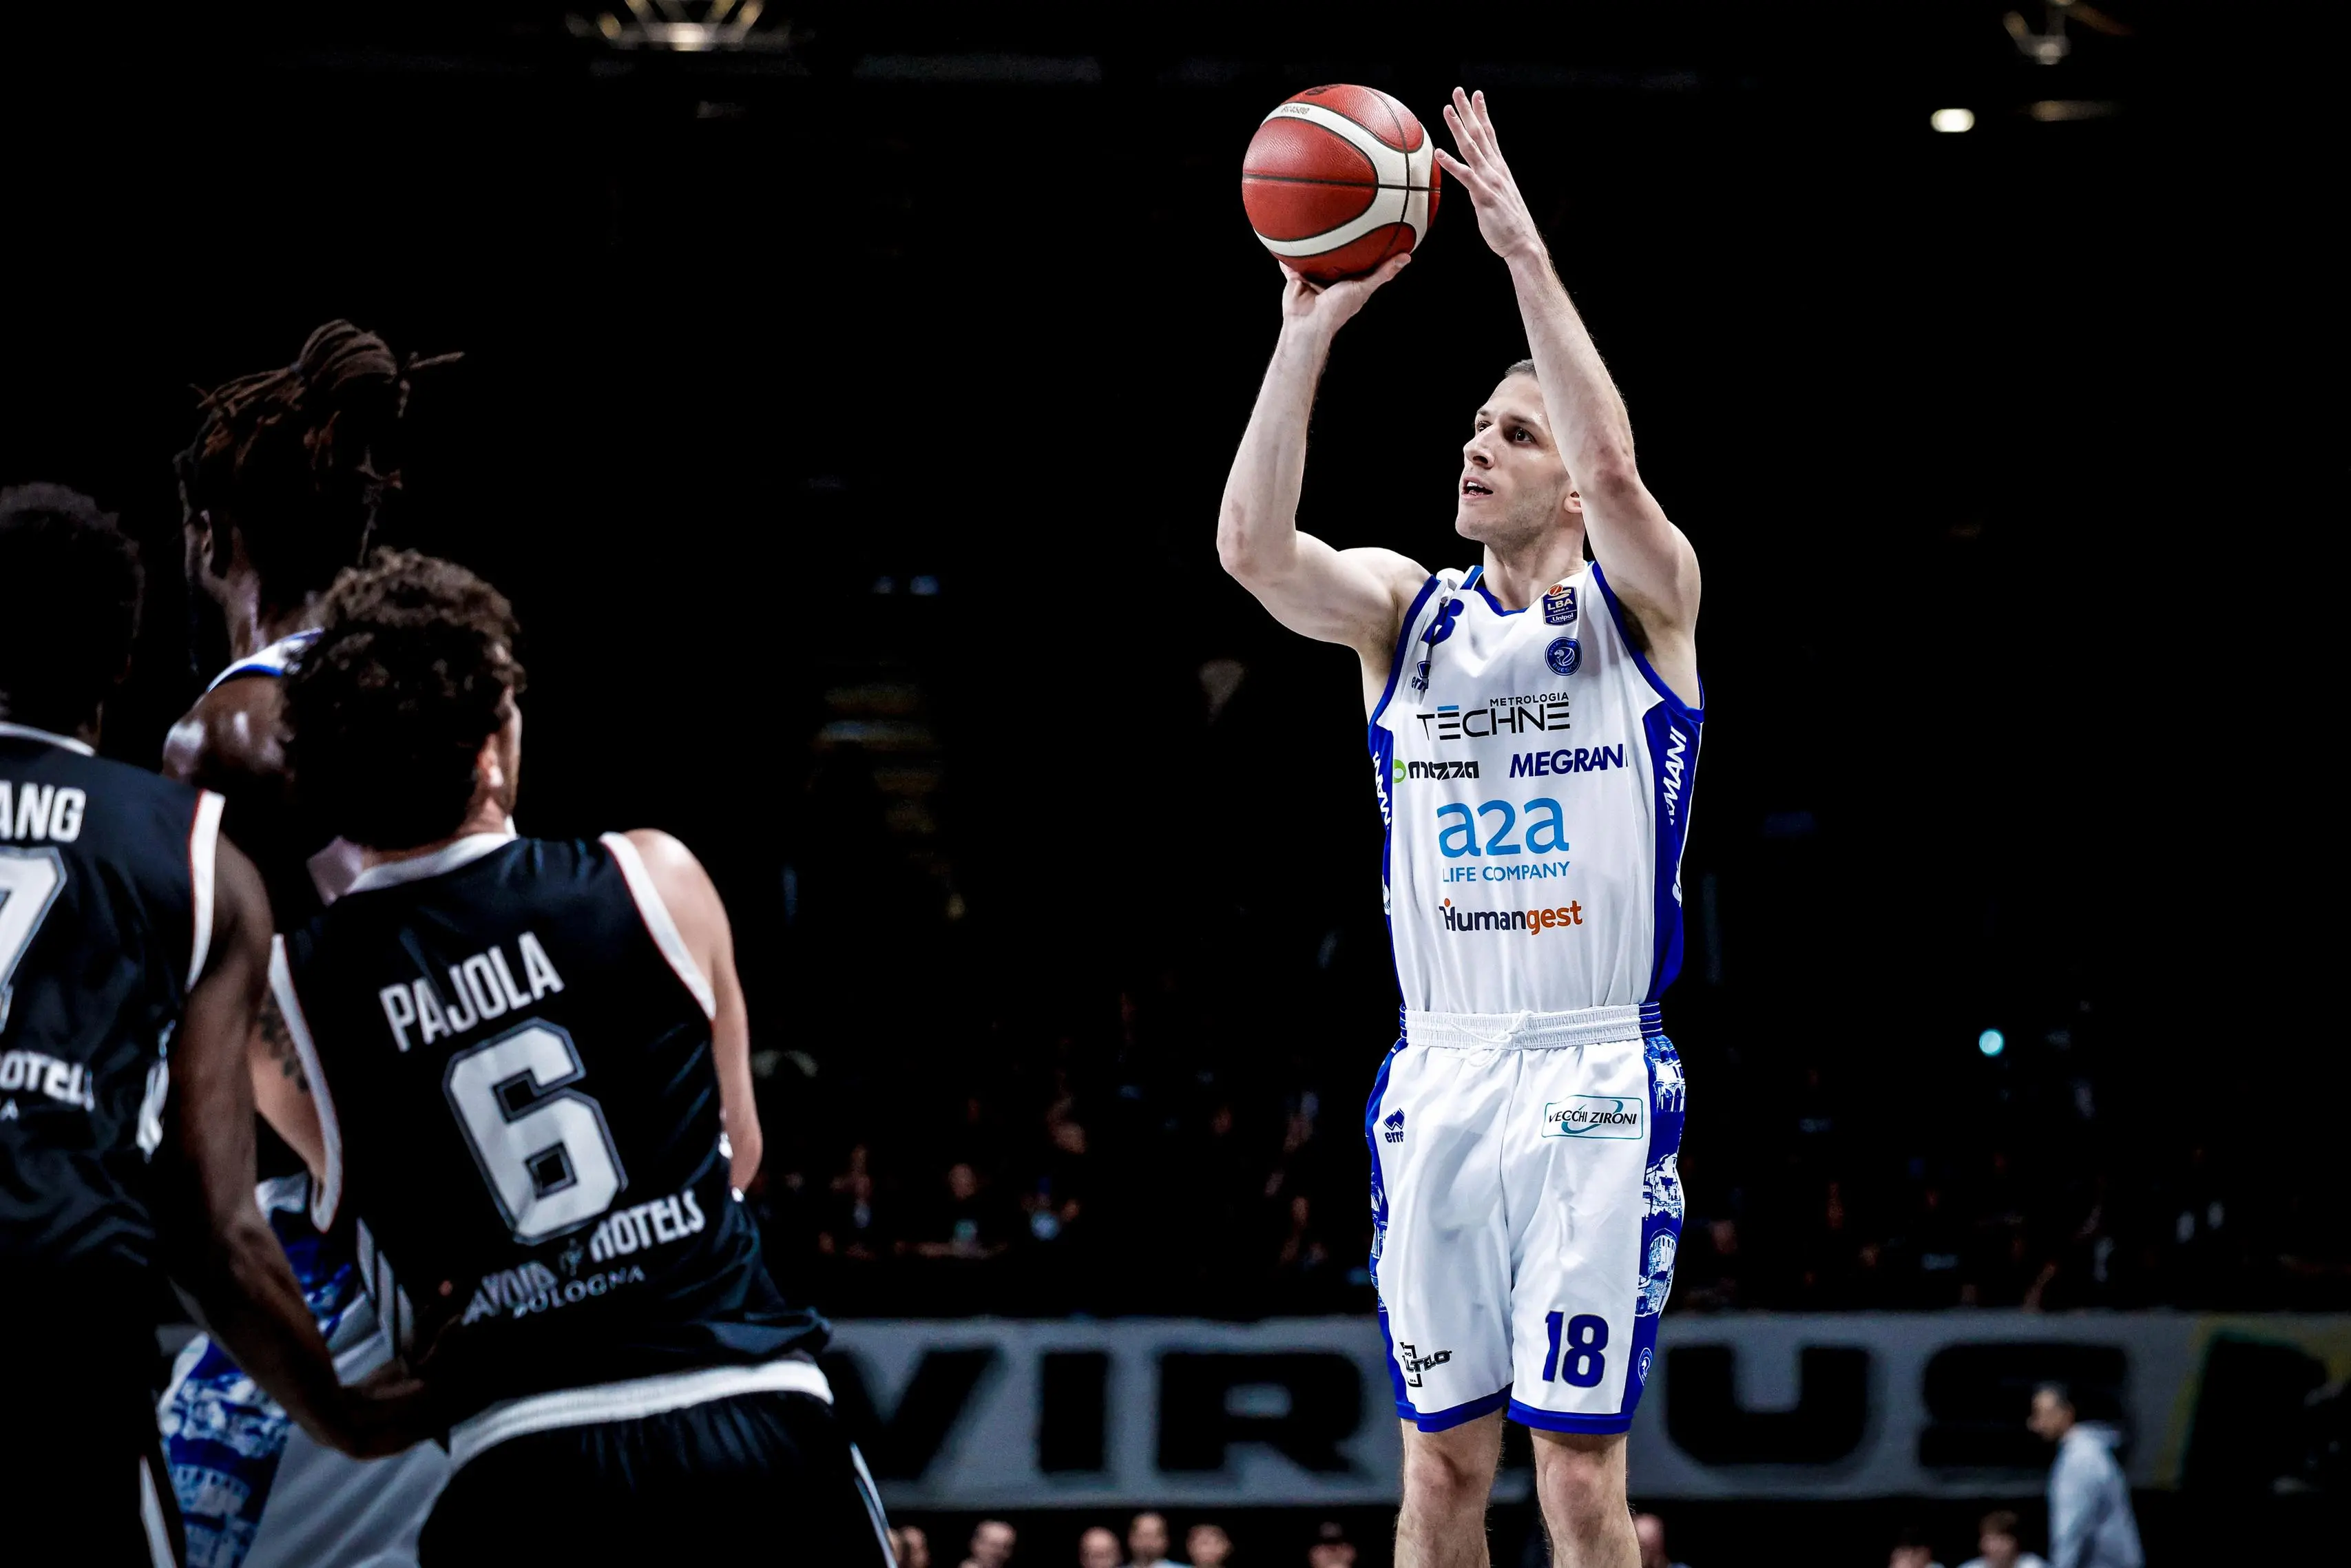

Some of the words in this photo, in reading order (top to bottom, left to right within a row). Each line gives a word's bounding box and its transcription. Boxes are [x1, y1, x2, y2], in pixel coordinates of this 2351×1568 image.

[1547, 598, 1574, 611] LBA
[1552, 612, 1574, 621] Unipol
[1490, 691, 1569, 707] METROLOGIA
[1417, 701, 1571, 740] TECHNE
[1509, 743, 1629, 778] MEGRAN
[1436, 797, 1569, 858] a2a
[1442, 866, 1476, 882] LIFE
[1482, 861, 1571, 881] COMPANY
[1439, 897, 1583, 936] Humangest
[379, 931, 565, 1052] PAJOLA
[441, 1016, 628, 1246] 6
[1549, 1109, 1588, 1123] VECCHI
[1589, 1111, 1638, 1125] ZIRONI
[1543, 1310, 1609, 1388] 18
[821, 1348, 2125, 1478] VIRUS
